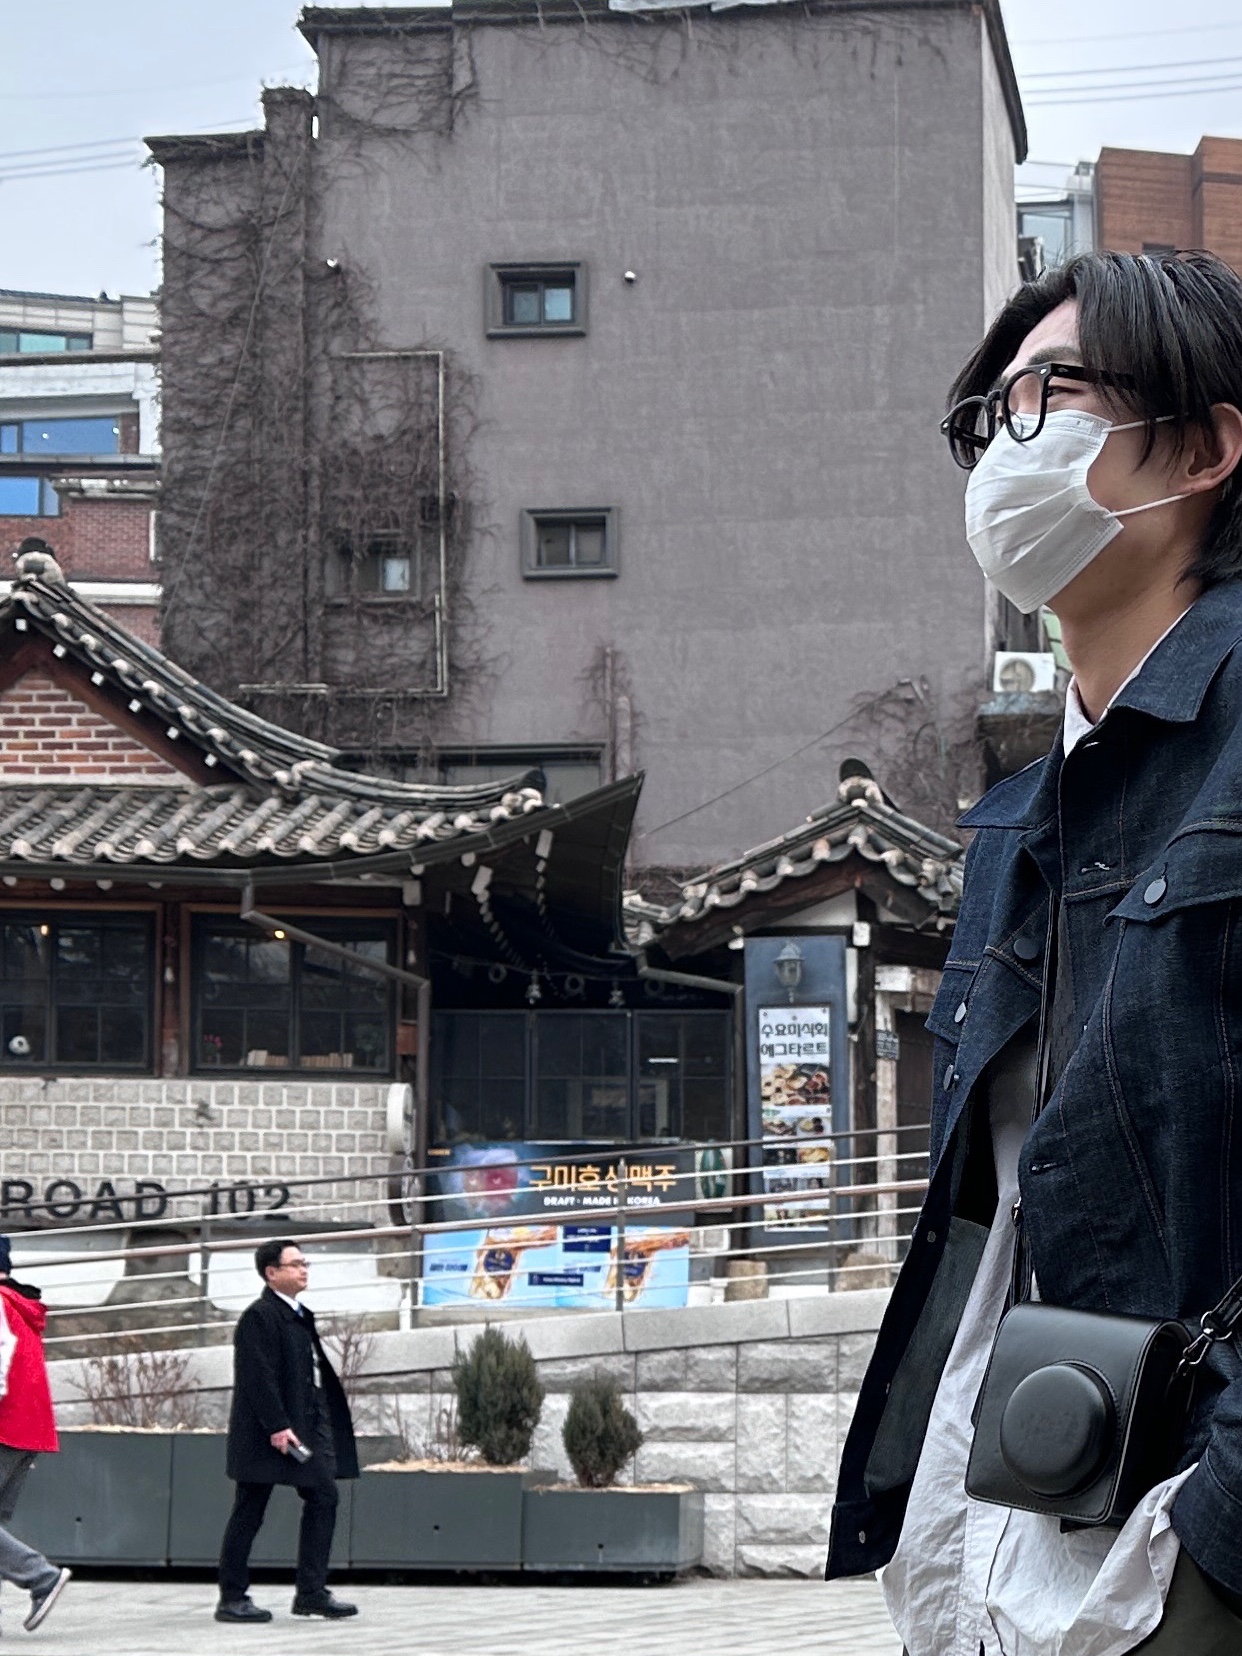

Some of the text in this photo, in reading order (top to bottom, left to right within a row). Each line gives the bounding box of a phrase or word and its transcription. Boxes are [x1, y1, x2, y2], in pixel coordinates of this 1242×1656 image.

[761, 1022, 829, 1039] 수요미식회
[760, 1041, 828, 1059] 에그타르트
[1, 1180, 291, 1220] ROAD 102
